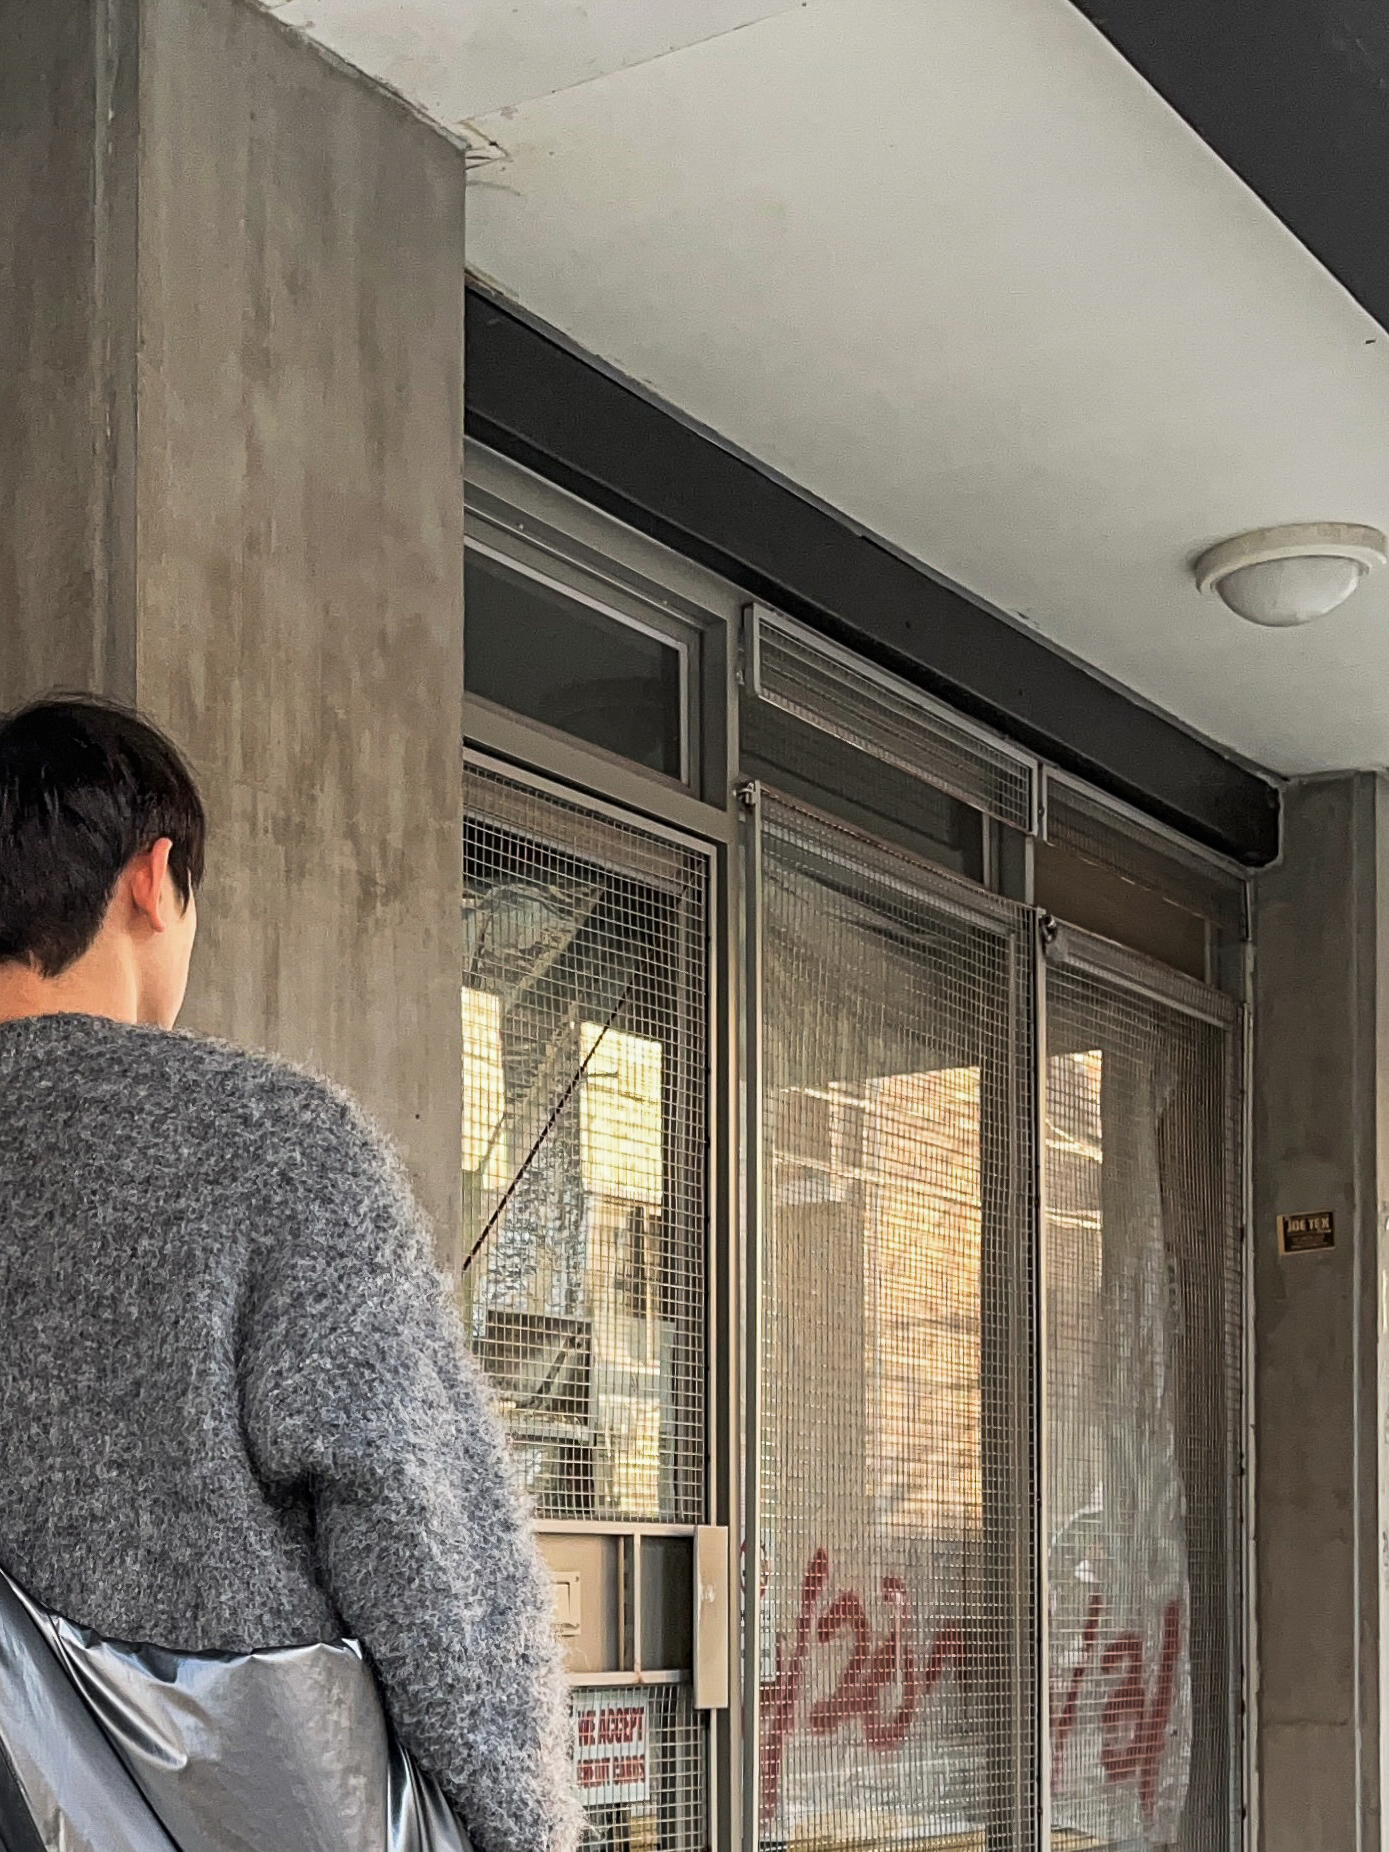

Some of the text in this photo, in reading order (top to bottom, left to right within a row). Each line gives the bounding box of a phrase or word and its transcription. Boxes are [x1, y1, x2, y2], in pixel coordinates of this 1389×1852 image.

[577, 1706, 644, 1747] WE ACCEPT
[612, 1753, 646, 1786] CARDS
